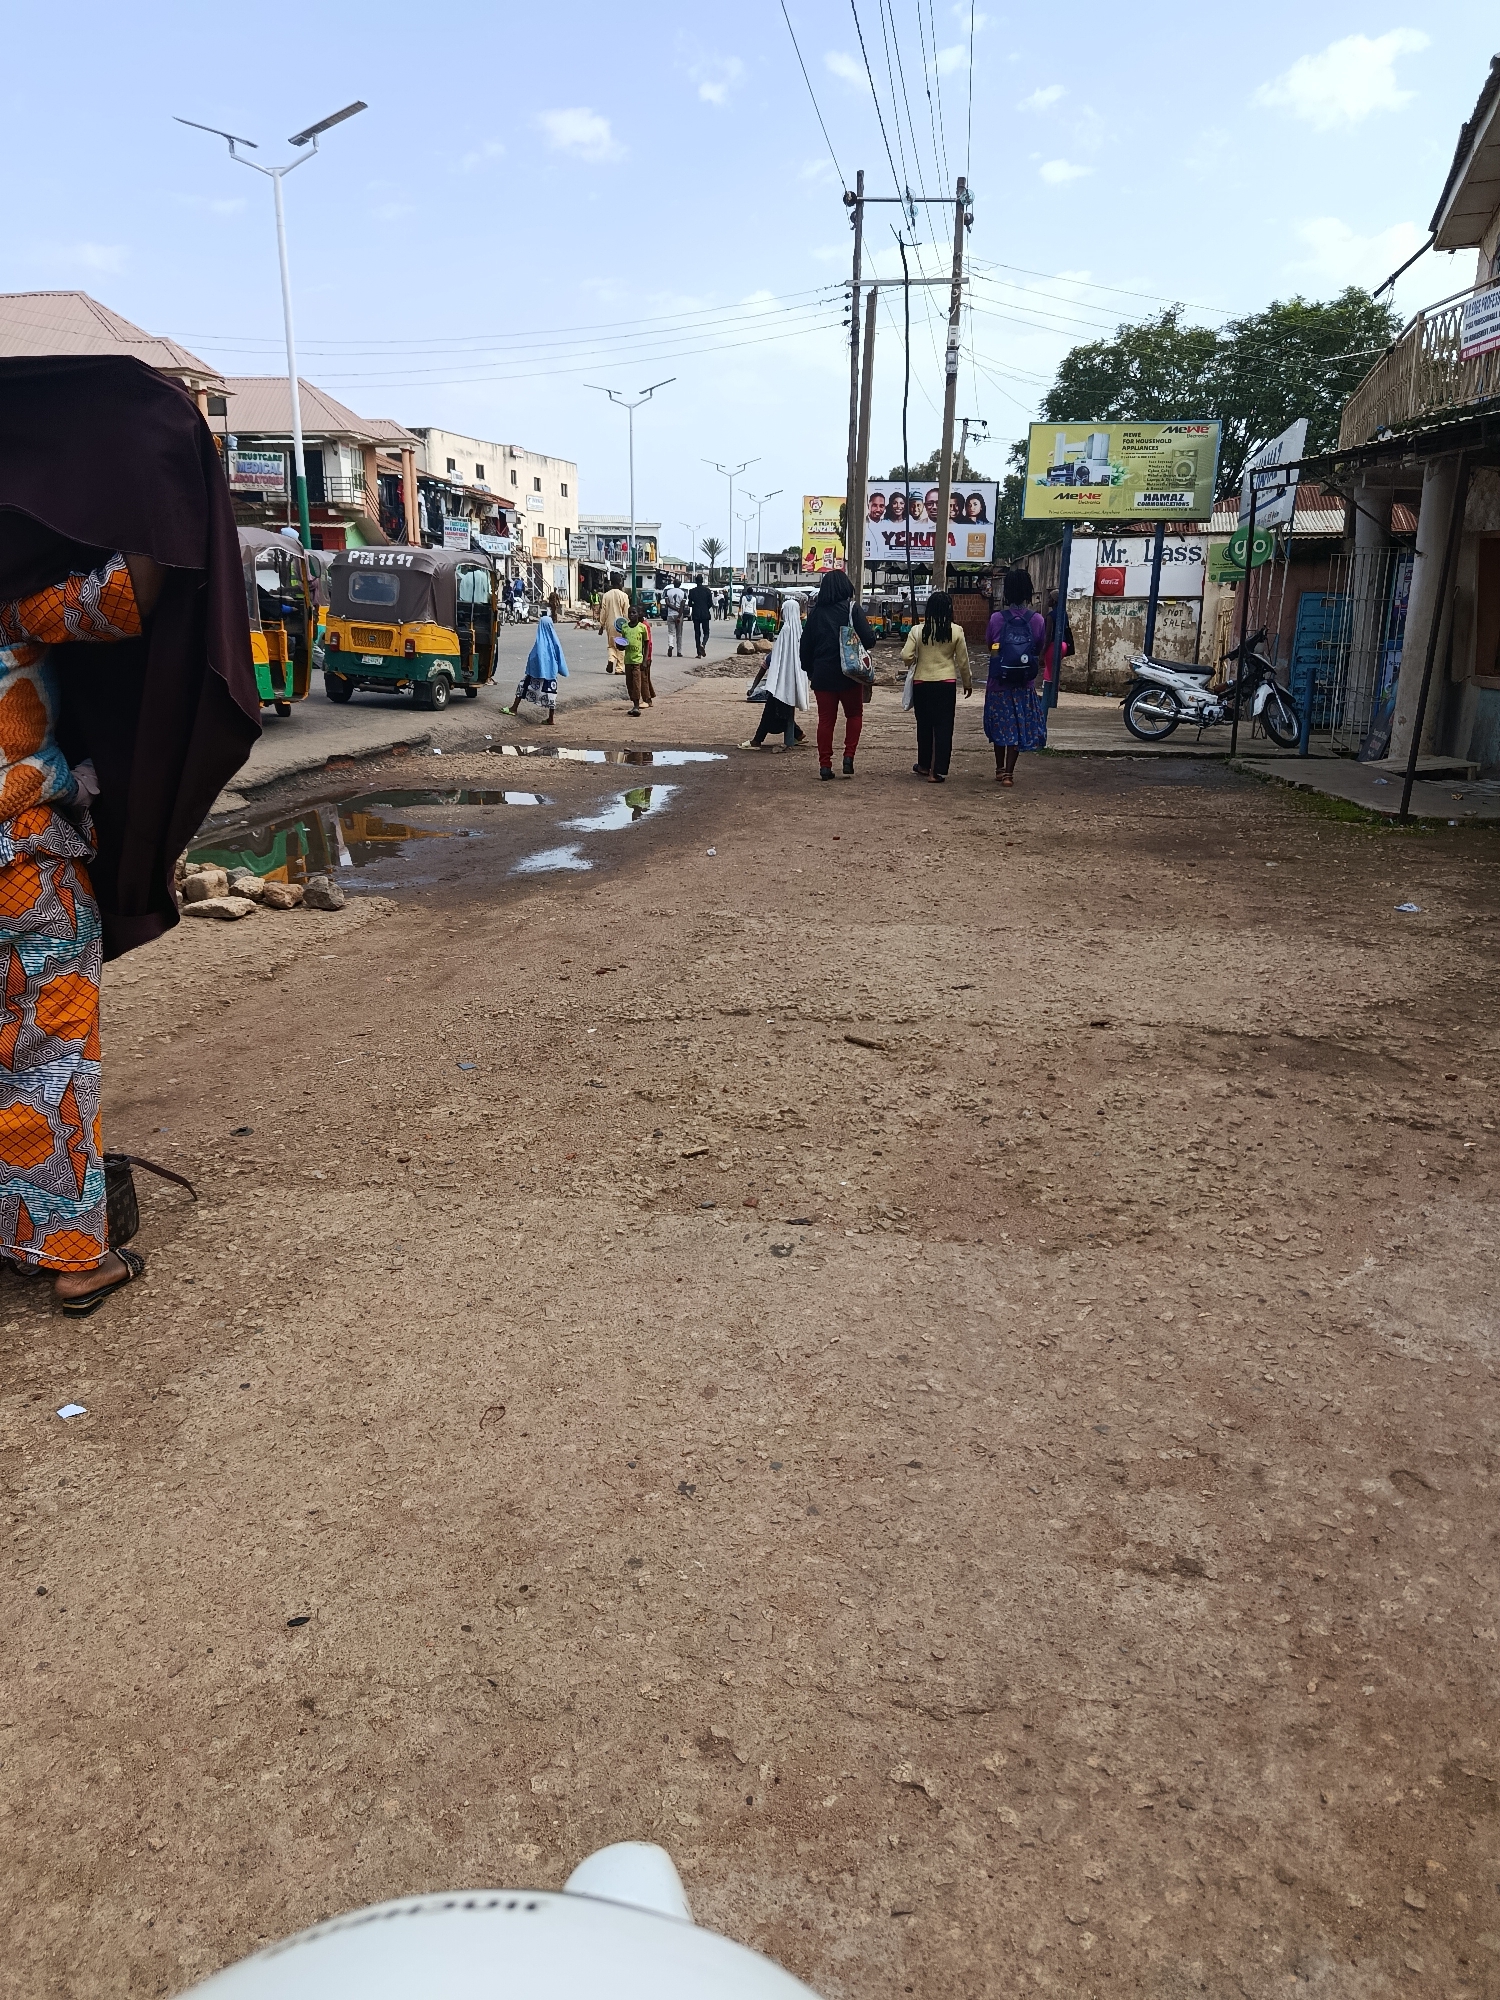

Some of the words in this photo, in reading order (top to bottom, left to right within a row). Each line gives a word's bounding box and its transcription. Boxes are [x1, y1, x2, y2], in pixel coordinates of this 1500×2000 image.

[237, 452, 283, 461] TRUSTCARE
[236, 461, 283, 475] MEDICAL
[1053, 492, 1101, 500] MeWe
[1143, 493, 1185, 501] HAMAZ
[1100, 539, 1129, 563] Mr.
[1143, 538, 1203, 562] Lass
[1167, 608, 1184, 617] NOT
[1162, 618, 1187, 628] SALE
